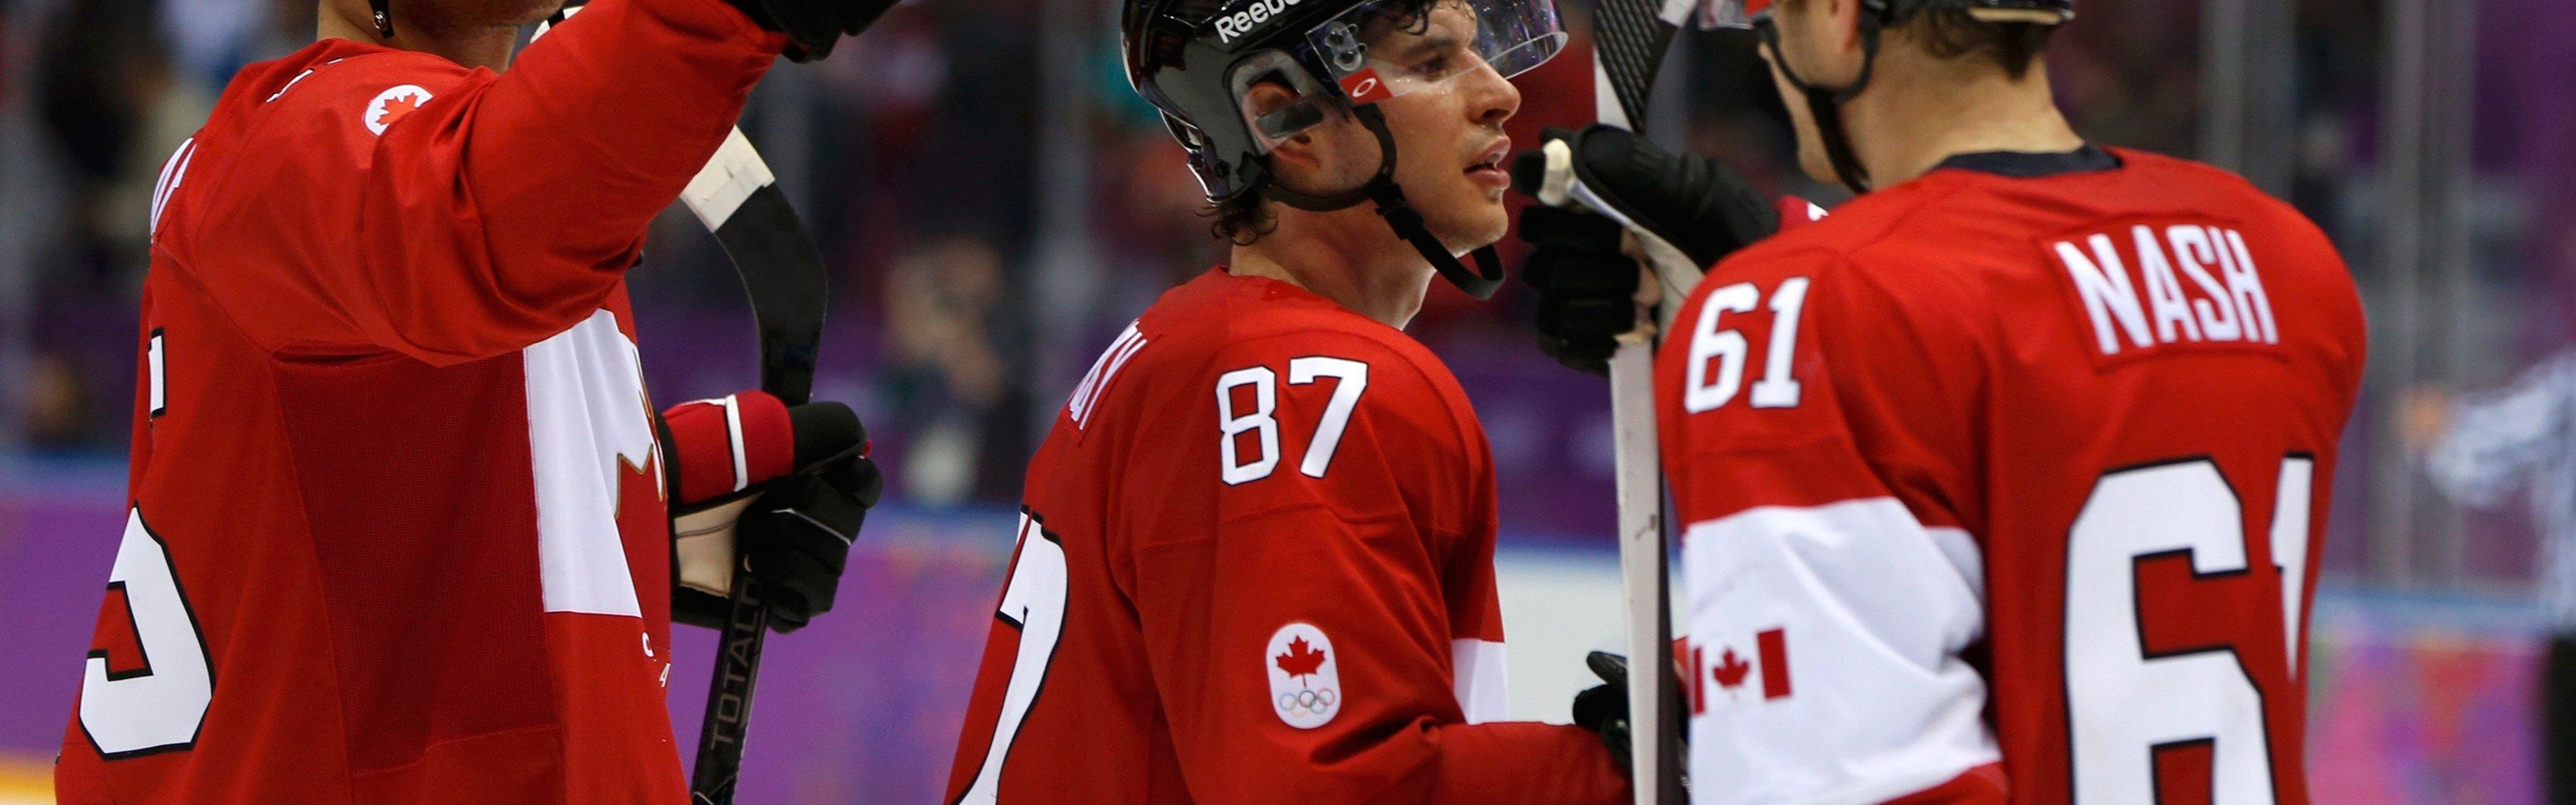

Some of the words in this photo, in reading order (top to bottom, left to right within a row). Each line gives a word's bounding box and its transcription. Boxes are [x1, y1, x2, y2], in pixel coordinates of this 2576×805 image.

[1684, 275, 1811, 414] 61
[2055, 224, 2279, 355] NASH
[1215, 355, 1368, 487] 87
